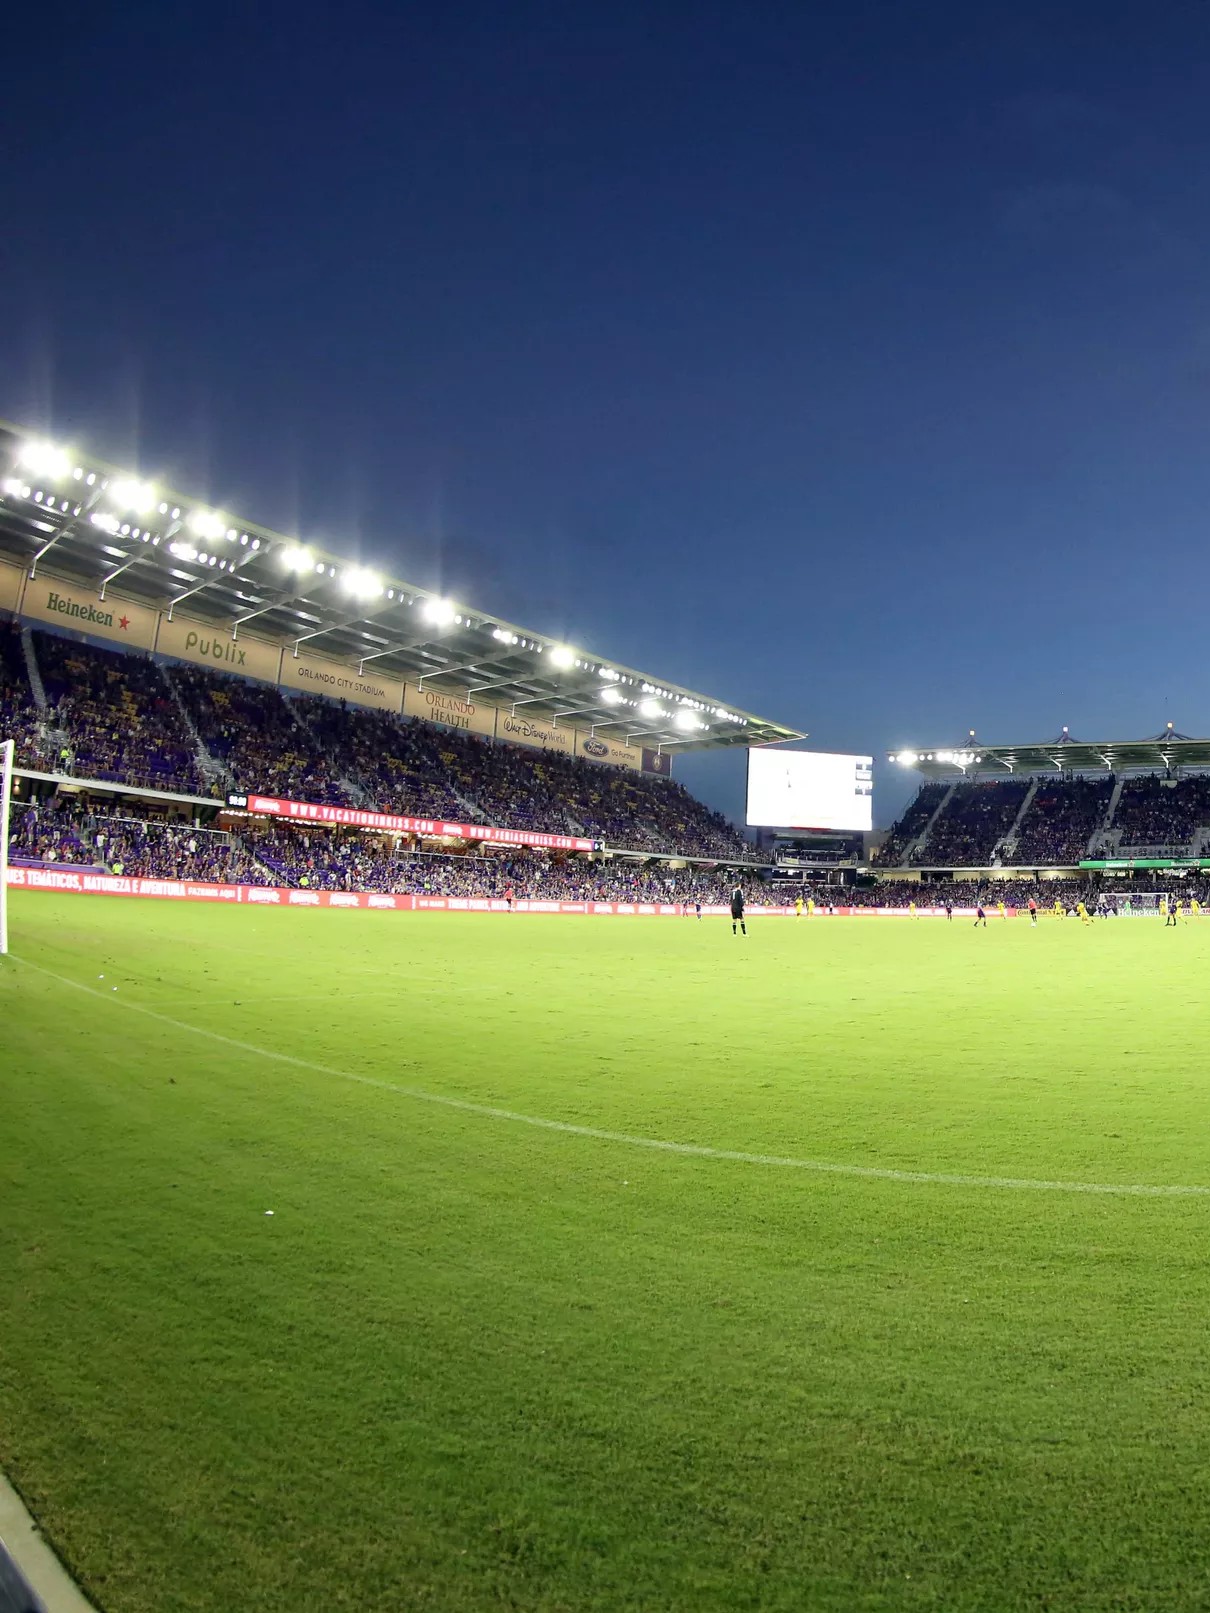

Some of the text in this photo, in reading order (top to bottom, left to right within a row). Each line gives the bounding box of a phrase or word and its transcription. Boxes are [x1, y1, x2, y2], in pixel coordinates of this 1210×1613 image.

[47, 592, 113, 627] Heineken
[186, 631, 246, 666] Publix
[297, 667, 385, 697] ORLANDO CITY STADIUM
[425, 691, 475, 716] ORLANDO
[430, 707, 469, 729] HEALTH
[132, 879, 139, 893] E
